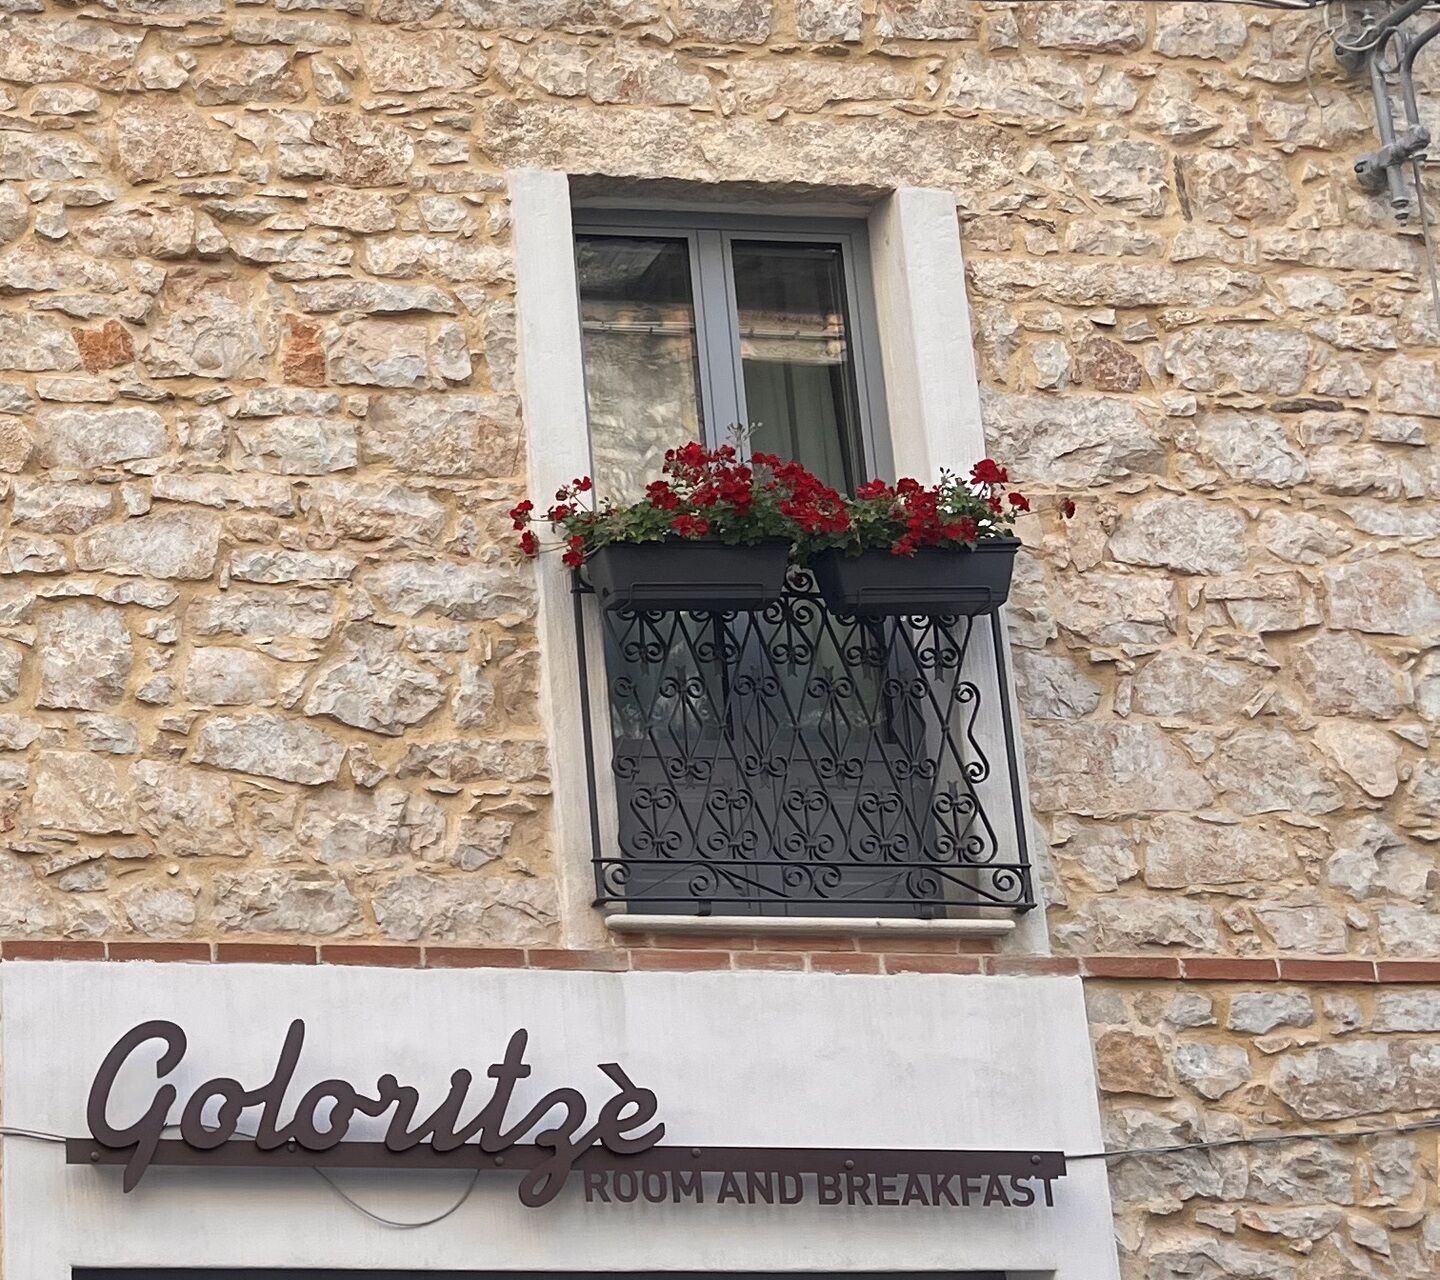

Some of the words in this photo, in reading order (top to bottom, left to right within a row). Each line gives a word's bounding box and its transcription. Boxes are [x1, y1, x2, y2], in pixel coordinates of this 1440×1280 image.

[86, 1018, 666, 1208] Goloritzè
[584, 1169, 704, 1204] ROOM
[717, 1170, 804, 1206] AND
[817, 1172, 1060, 1209] BREAKFAST
